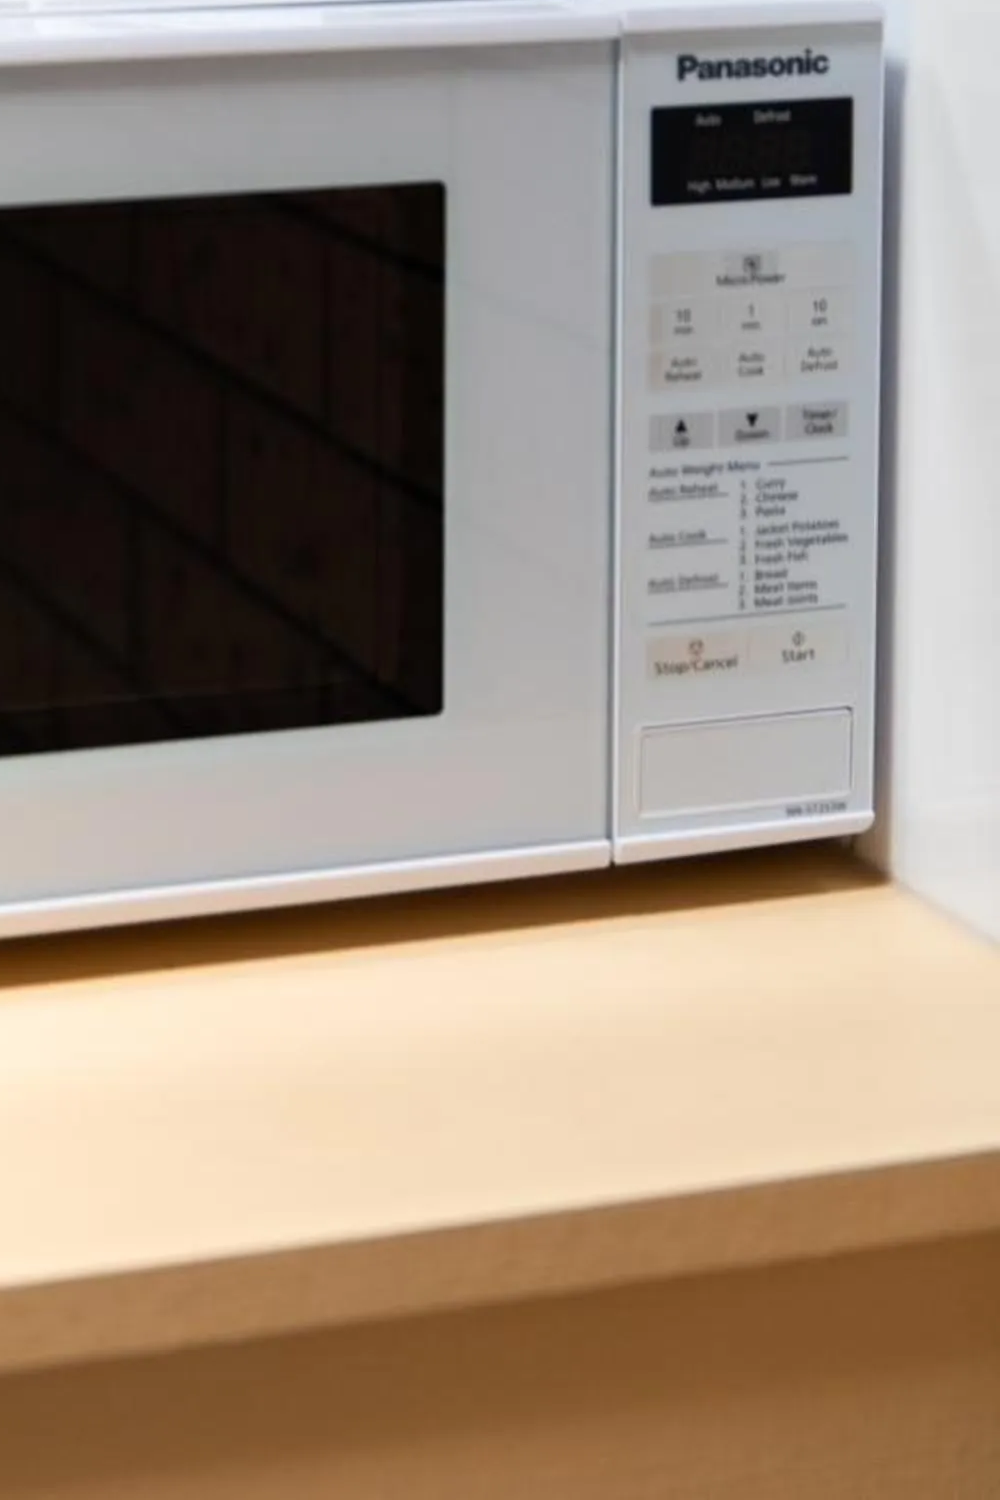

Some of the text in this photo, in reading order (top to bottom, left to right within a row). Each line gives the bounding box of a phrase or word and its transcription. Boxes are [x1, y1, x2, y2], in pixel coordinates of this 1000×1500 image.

[676, 49, 829, 81] Panasonic
[695, 114, 722, 128] Auto
[813, 298, 827, 314] 10
[727, 461, 761, 472] Menu
[755, 478, 787, 492] Curry
[781, 648, 816, 664] Start
[654, 655, 739, 676] Stop/Cancel
